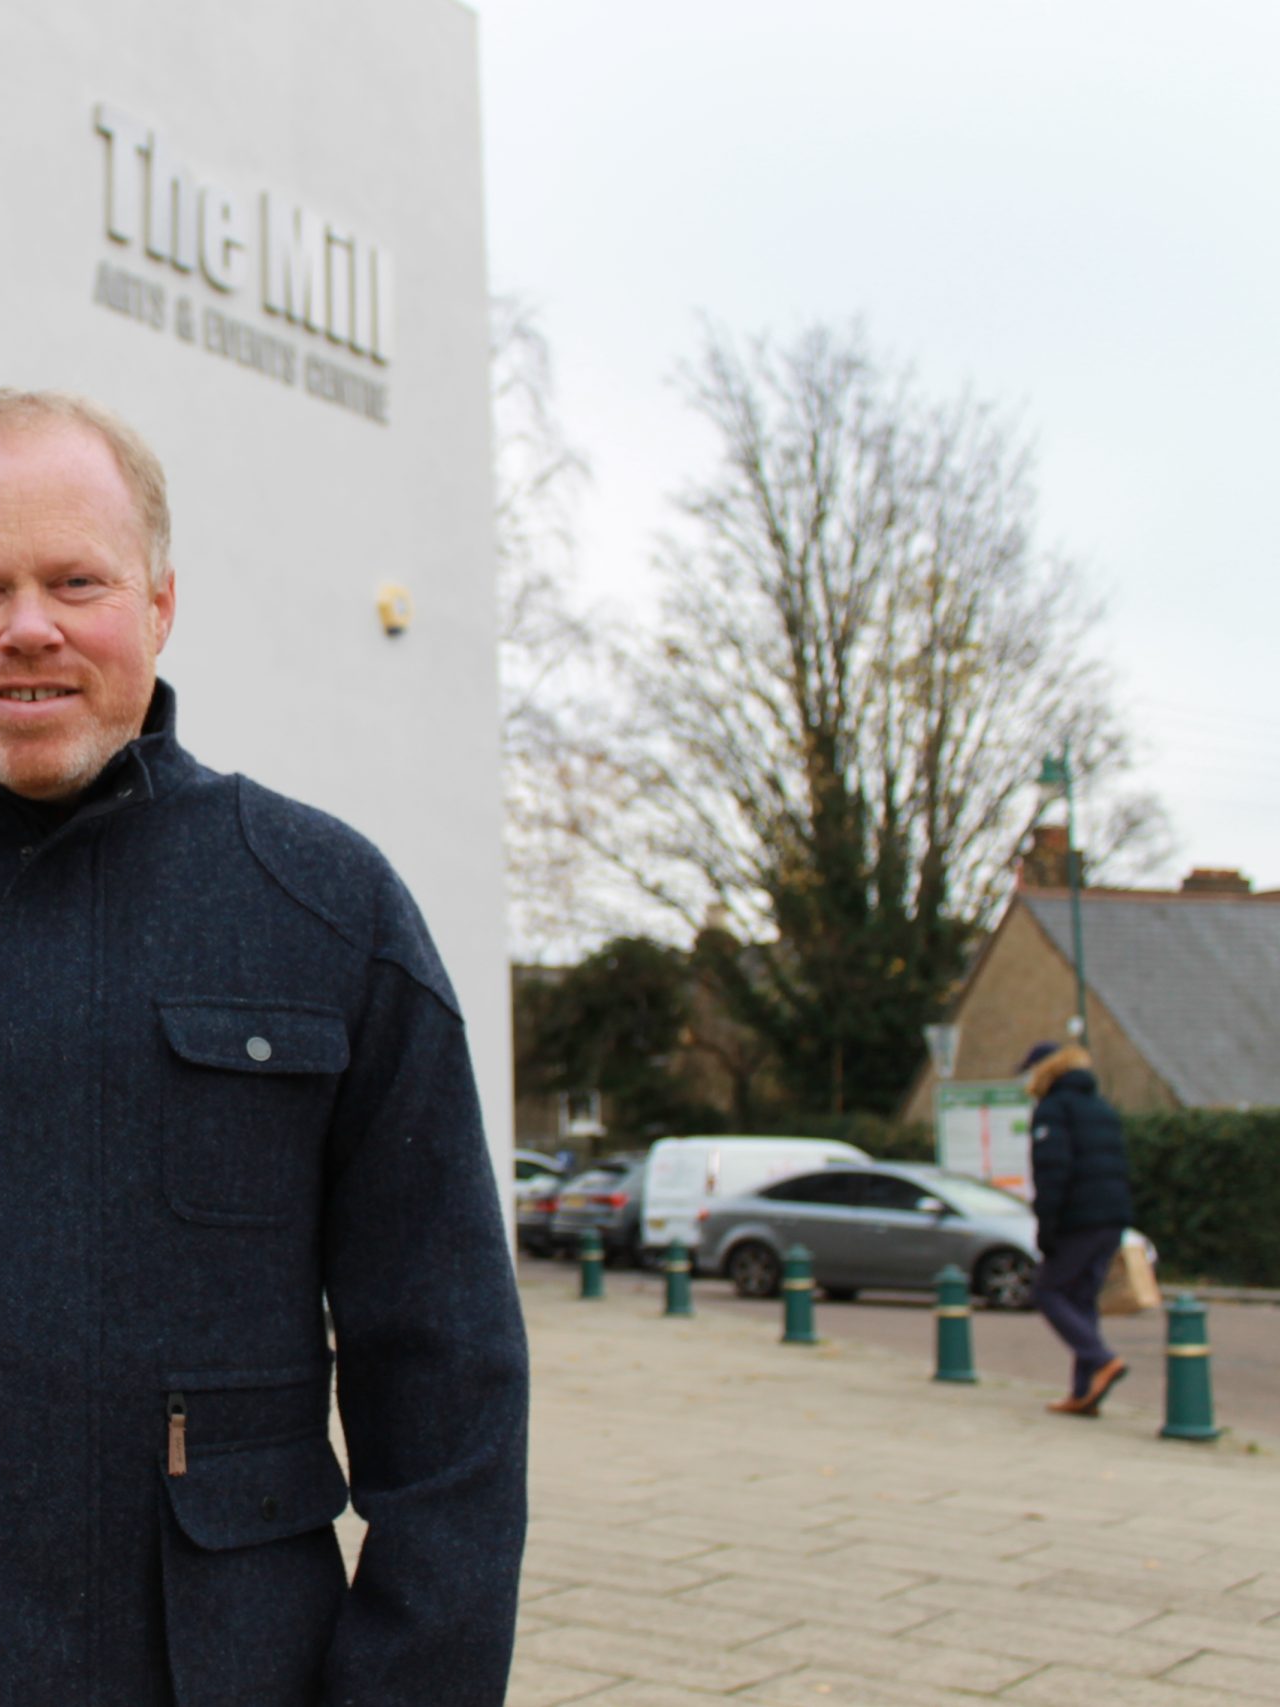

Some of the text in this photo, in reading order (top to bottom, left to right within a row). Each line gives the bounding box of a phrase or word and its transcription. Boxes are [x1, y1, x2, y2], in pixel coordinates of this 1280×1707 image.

[93, 100, 394, 367] The Mill
[93, 259, 390, 425] ARTS & EVENTS CENTRE
